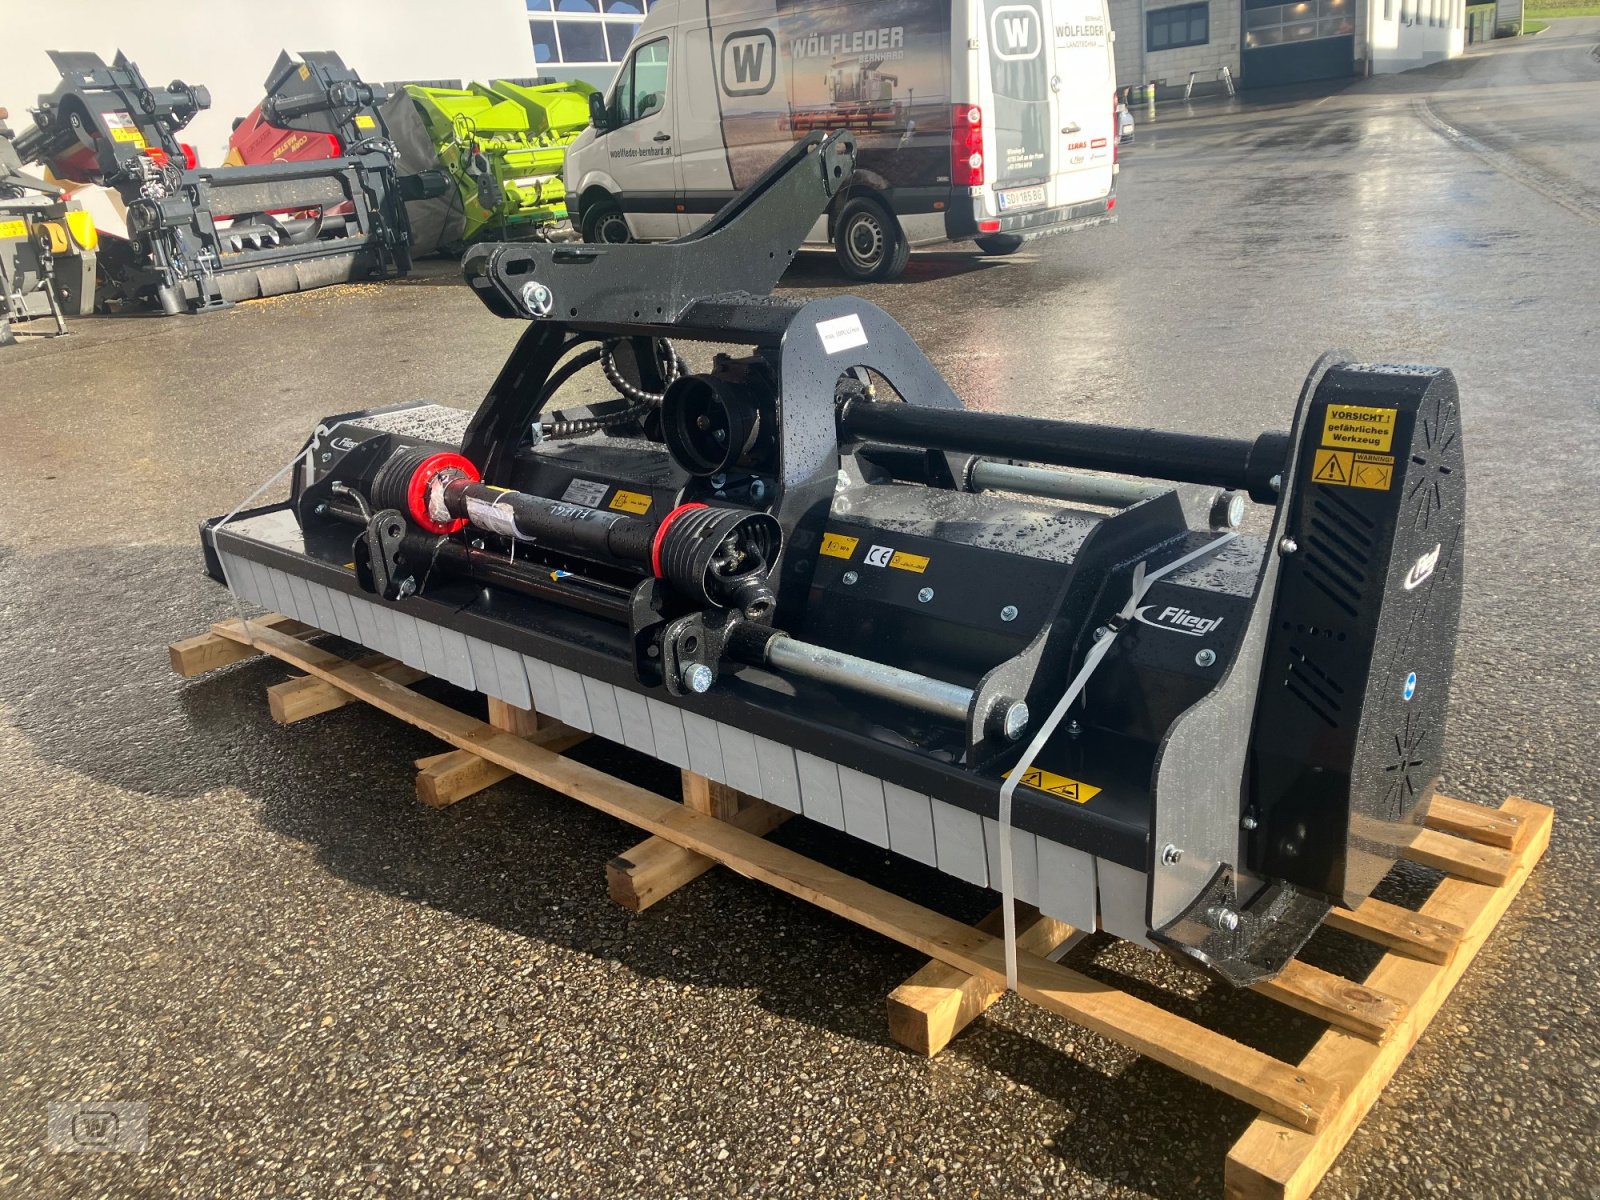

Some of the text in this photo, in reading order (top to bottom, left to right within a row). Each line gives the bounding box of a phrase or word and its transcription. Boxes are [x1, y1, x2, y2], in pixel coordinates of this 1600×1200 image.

[1003, 17, 1029, 48] W
[1055, 22, 1104, 37] WÖLFLEDER
[790, 26, 904, 59] WÖLFLEDER
[732, 42, 765, 83] W
[858, 50, 904, 64] BERNHARD
[609, 146, 672, 158] woelfleder-bernhard.at
[1331, 410, 1385, 423] VORSICHT
[1327, 423, 1389, 436] gefährliches
[1332, 433, 1381, 446] Werkzeug
[1357, 454, 1394, 464] WARNING!
[1157, 606, 1225, 634] Fliegl
